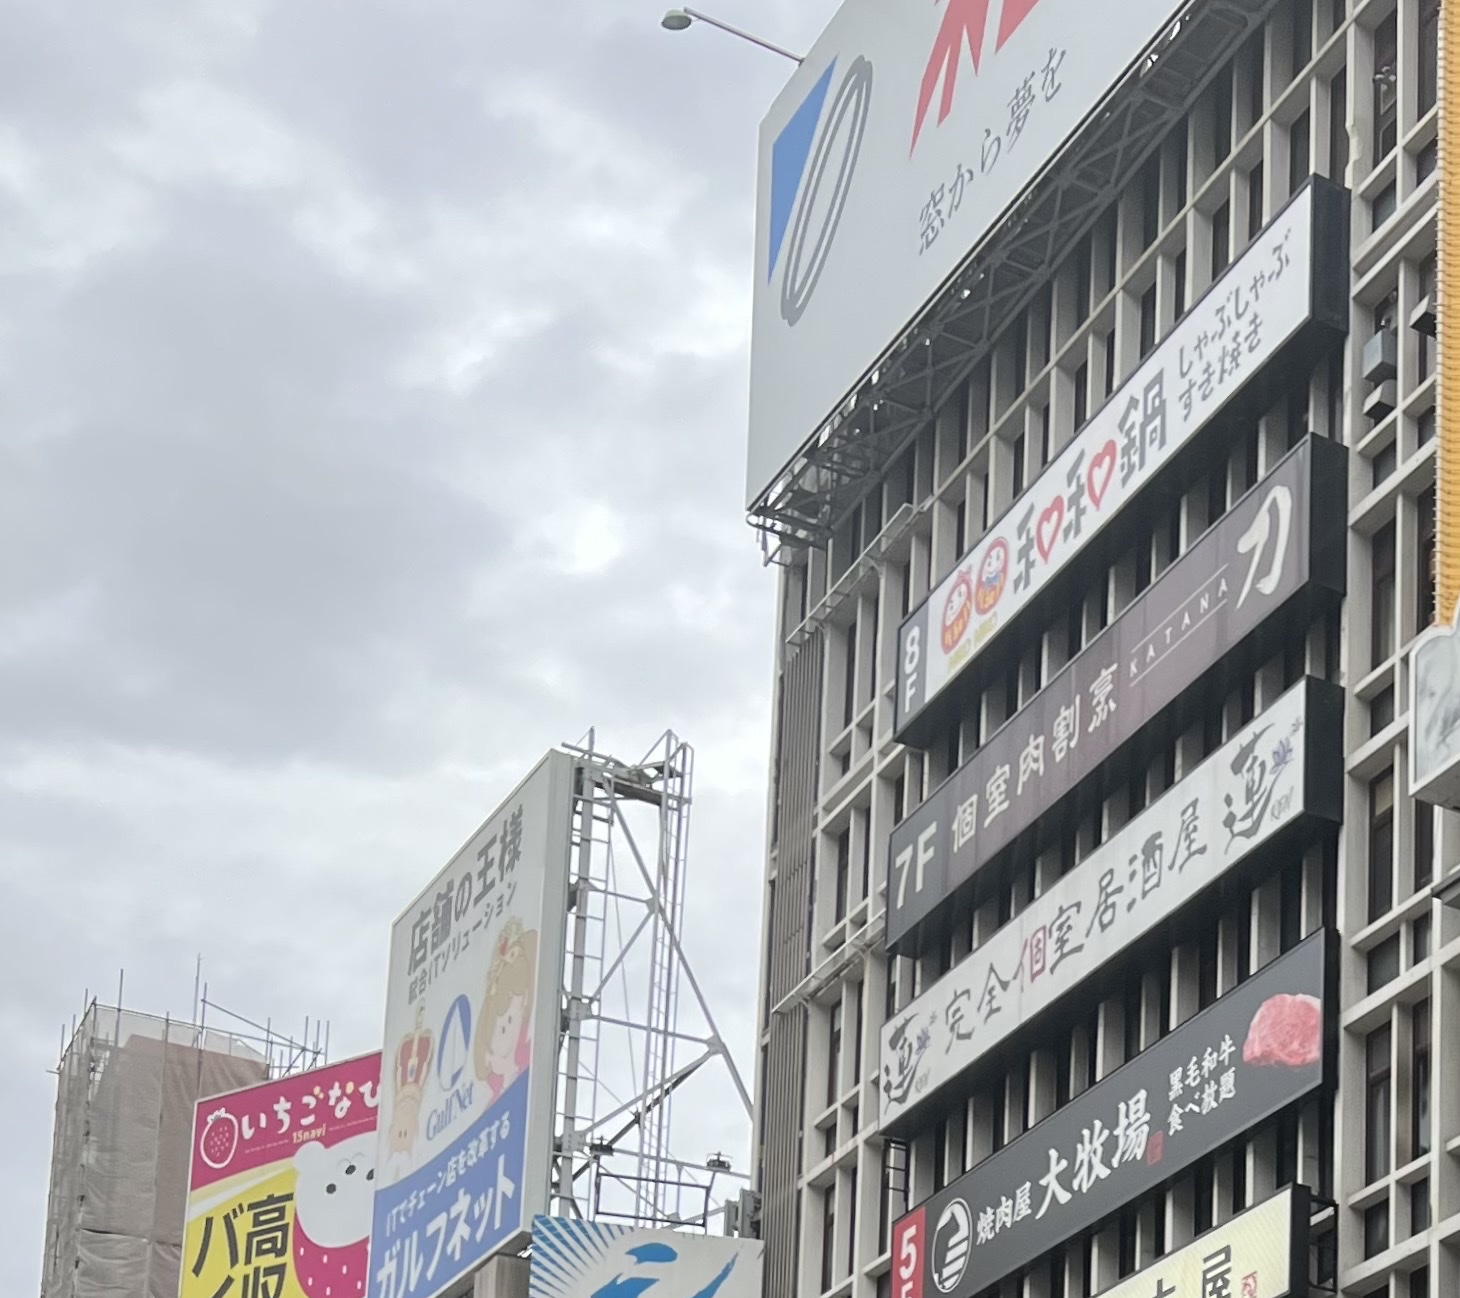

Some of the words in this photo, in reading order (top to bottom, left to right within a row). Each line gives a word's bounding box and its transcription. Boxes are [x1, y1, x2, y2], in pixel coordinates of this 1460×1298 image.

[1178, 312, 1262, 422] すき焼き
[1179, 228, 1292, 379] しゃぶしゃぶ
[895, 822, 937, 909] 7F
[951, 662, 1118, 853] 個室肉割烹
[1130, 578, 1228, 678] KATANA
[1235, 485, 1291, 609] 刀
[904, 625, 920, 713] 8F
[408, 803, 523, 976] 店舗の王様
[945, 797, 1208, 1055] 完全個室居酒屋
[1168, 1033, 1237, 1101] 黒毛和牛
[1168, 1066, 1237, 1136] 食べ放題
[976, 1181, 1032, 1245] 焼肉屋
[1036, 1088, 1151, 1220] 大牧場
